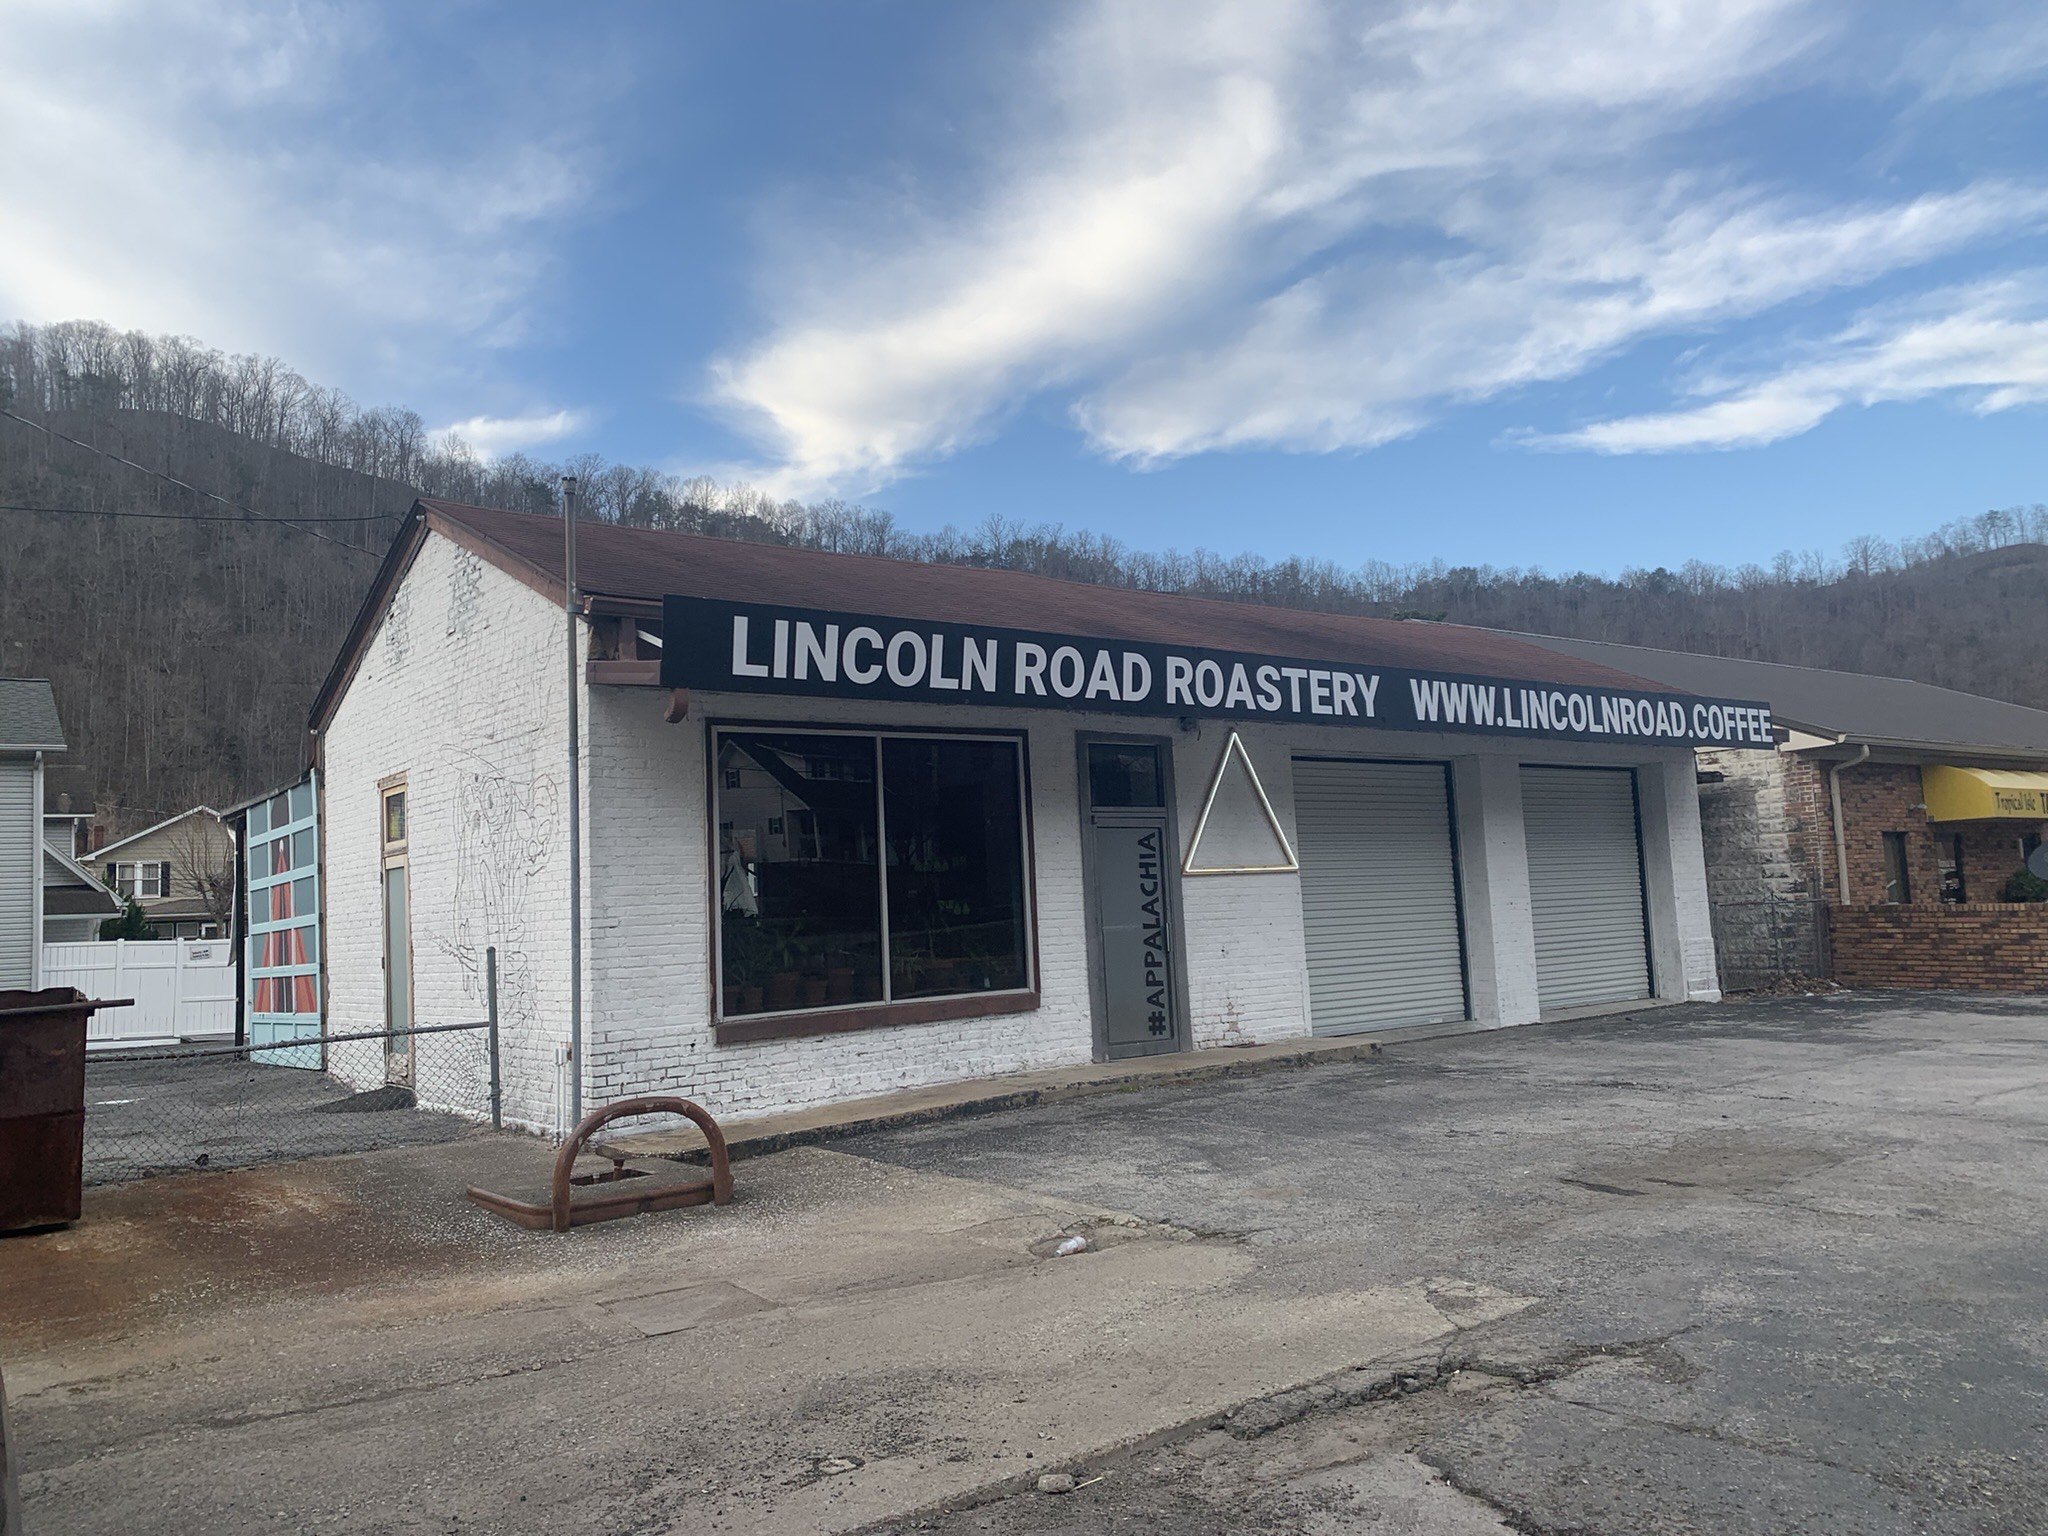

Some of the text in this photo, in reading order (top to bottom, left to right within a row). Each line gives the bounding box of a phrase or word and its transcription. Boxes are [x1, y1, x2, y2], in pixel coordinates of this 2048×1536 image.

[732, 615, 1773, 743] LINCOLN ROAD ROASTERY WWW.LINCOLNROAD.COFFEE
[1137, 831, 1167, 1036] #APPALACHIA
